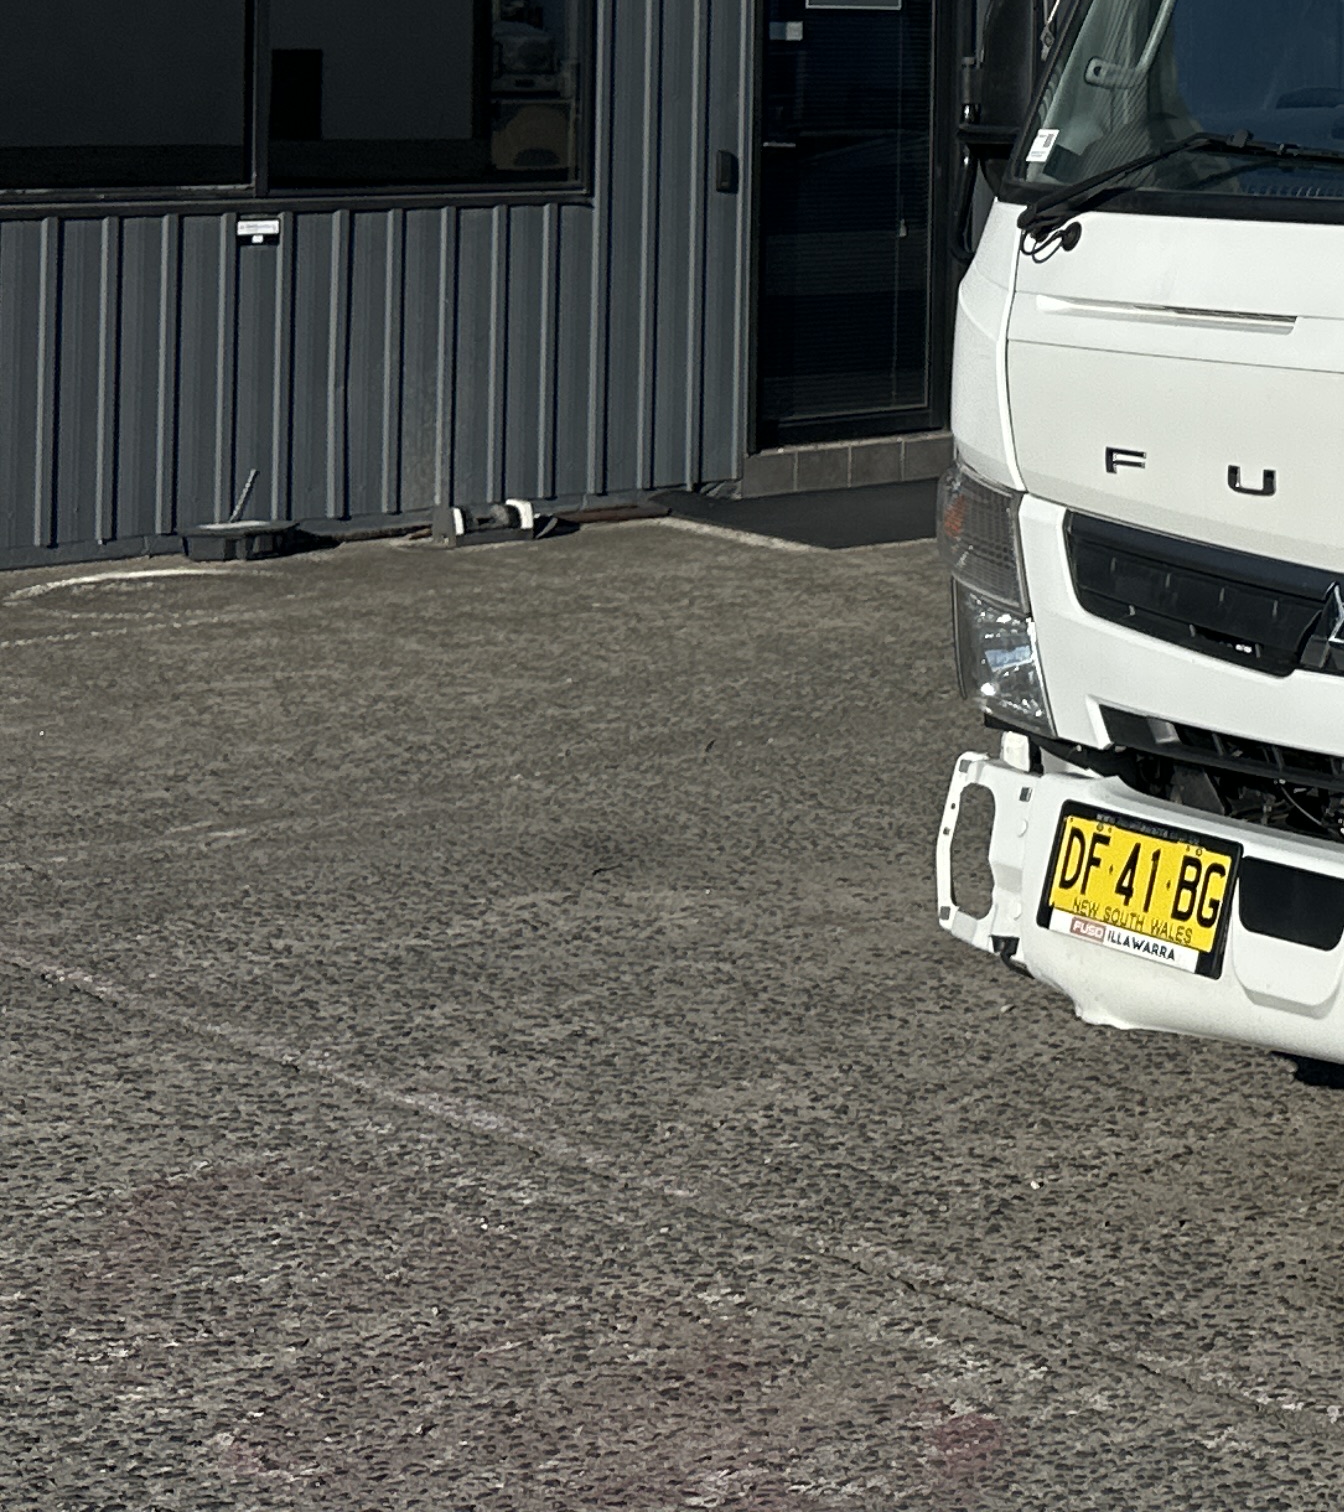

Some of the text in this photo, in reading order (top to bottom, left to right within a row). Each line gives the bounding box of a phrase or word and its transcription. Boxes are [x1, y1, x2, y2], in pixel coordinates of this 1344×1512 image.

[1072, 897, 1193, 944] NEW SOUTH WALES
[1072, 920, 1175, 961] FUSO ILLAWARRA
